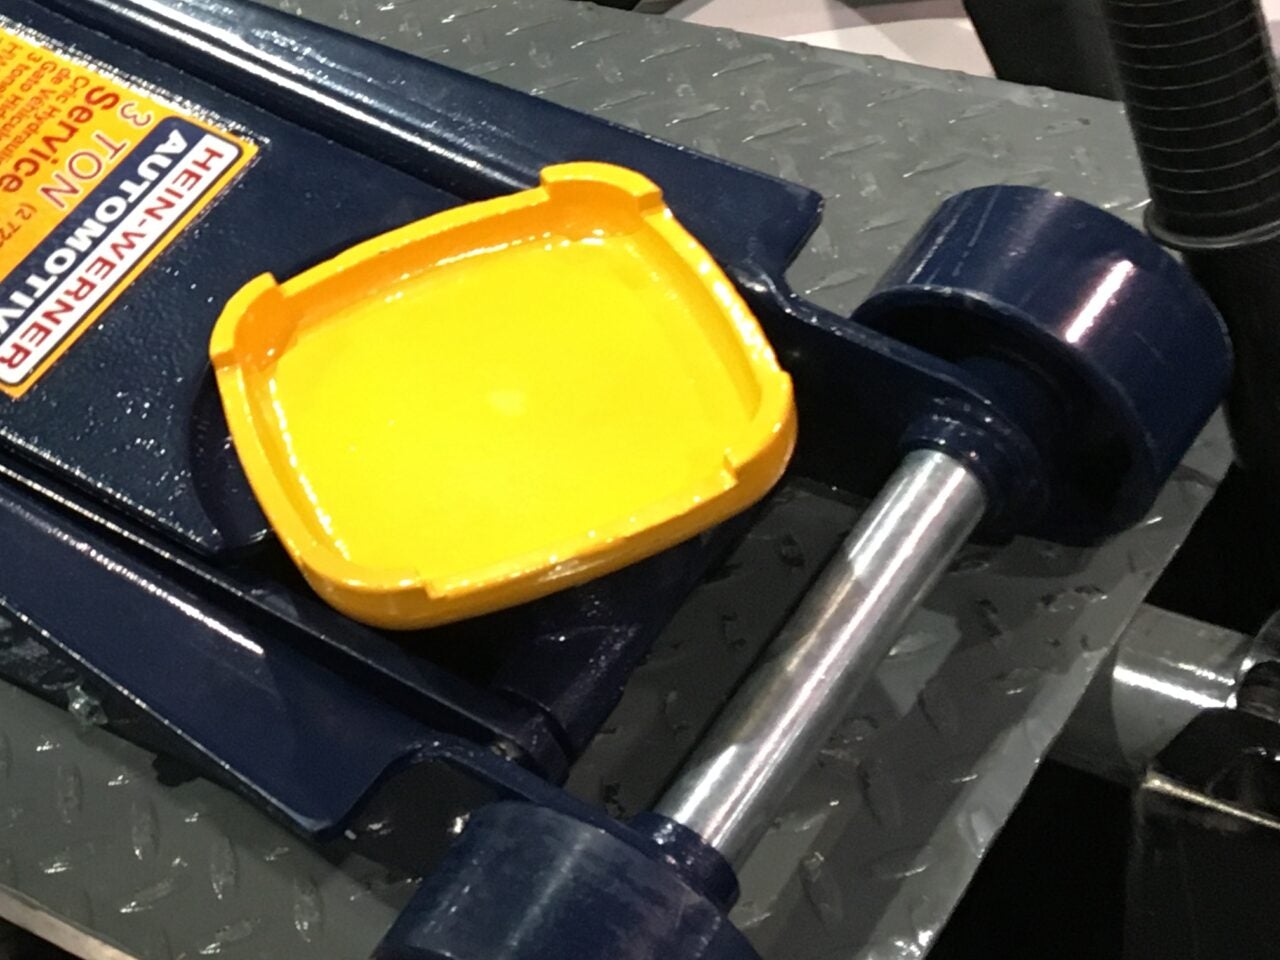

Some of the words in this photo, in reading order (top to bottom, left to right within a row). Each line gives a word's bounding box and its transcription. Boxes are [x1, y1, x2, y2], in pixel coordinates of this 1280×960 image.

[23, 50, 44, 64] 3
[14, 57, 59, 94] Gato
[46, 65, 76, 87] de
[52, 73, 92, 105] Cric
[111, 99, 158, 129] 3
[32, 128, 129, 210] TON
[10, 200, 39, 222] (2
